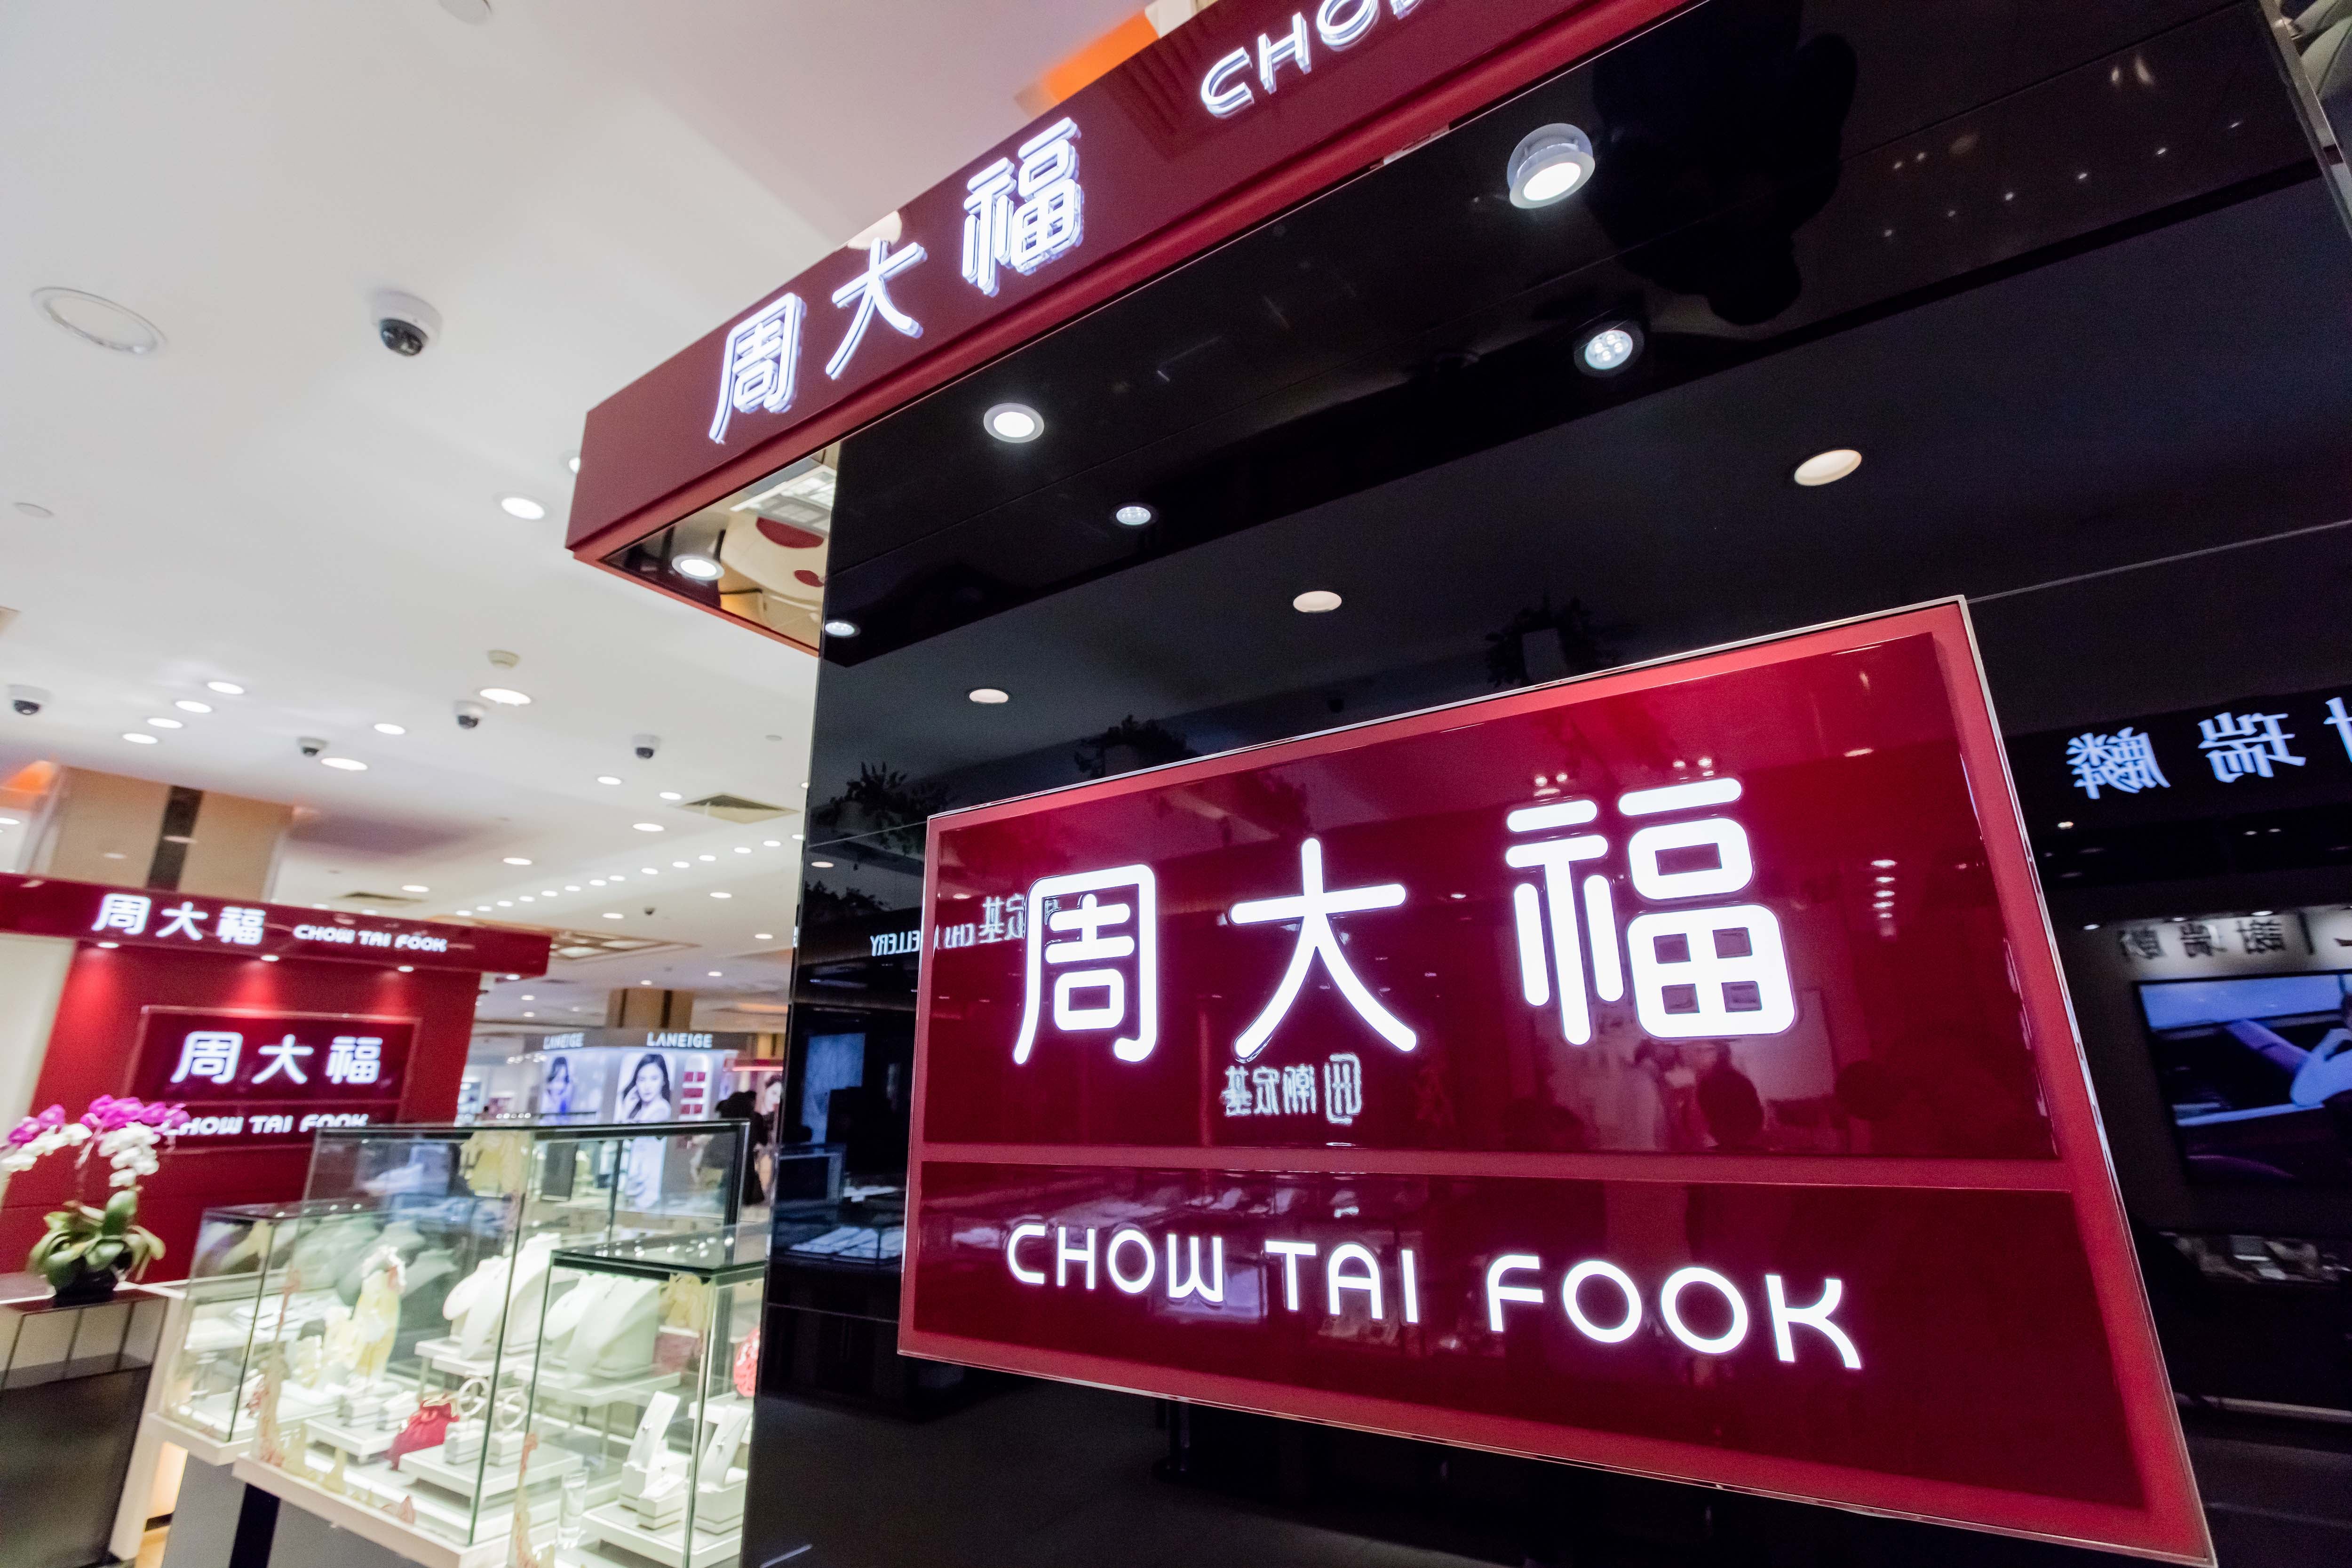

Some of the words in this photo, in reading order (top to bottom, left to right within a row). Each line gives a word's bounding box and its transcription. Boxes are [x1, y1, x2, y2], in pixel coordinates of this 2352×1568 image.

[1200, 0, 1425, 119] CHO
[708, 117, 1084, 444] 周大福
[91, 893, 266, 945] 周大福
[293, 924, 356, 944] CHOW
[358, 930, 392, 947] TAI
[394, 933, 447, 953] FOOK
[1012, 777, 1796, 1065] 周大福
[170, 1031, 383, 1084] 周大福
[646, 1032, 713, 1048] LANEIGE
[249, 1114, 294, 1133] TAI
[1007, 1223, 1224, 1303] CHOW
[1264, 1239, 1419, 1323] TAI
[1486, 1254, 1861, 1369] FOOK
